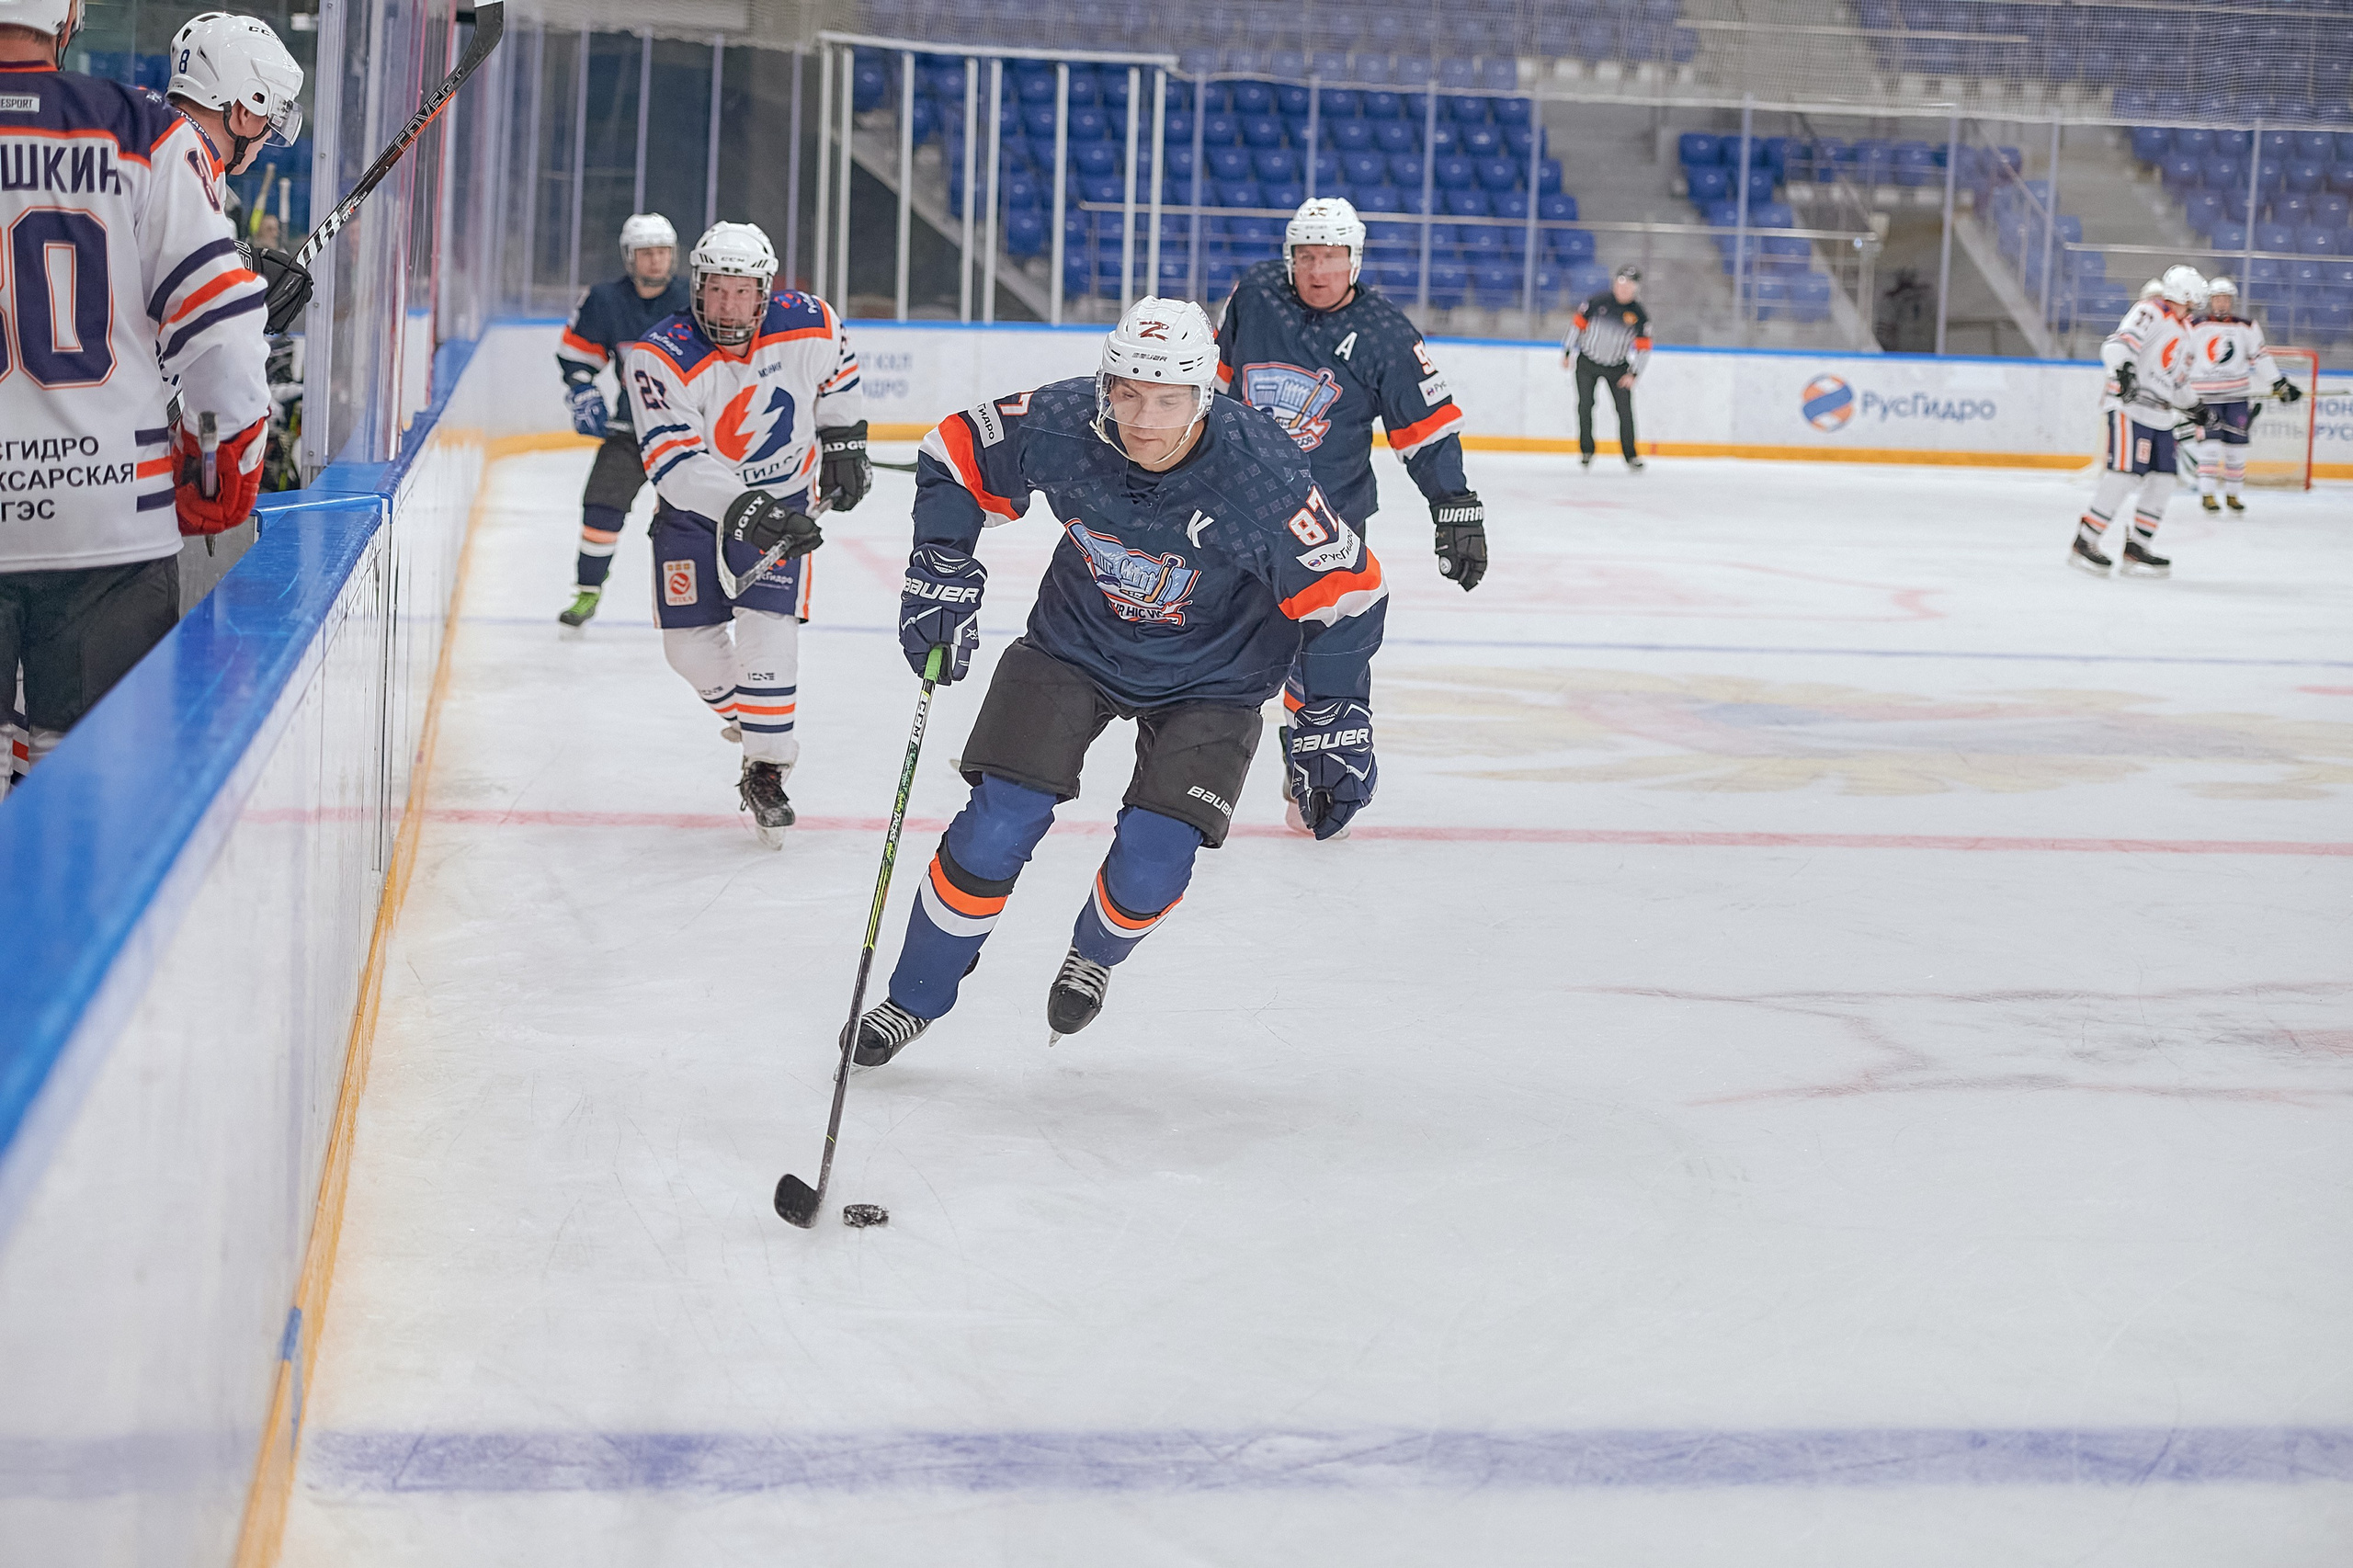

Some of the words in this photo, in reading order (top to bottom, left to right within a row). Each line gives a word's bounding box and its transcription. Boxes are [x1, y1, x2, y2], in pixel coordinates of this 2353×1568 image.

[178, 49, 190, 74] 8
[0, 143, 122, 196] ШКИН
[0, 206, 118, 391] 0
[1862, 390, 1996, 424] РусГидро
[0, 436, 99, 462] ГИДРО
[824, 442, 846, 454] AD
[0, 499, 55, 523] ГЭС
[1288, 485, 1338, 547] 87
[1319, 529, 1354, 562] РусГидро
[1127, 607, 1146, 619] HIC
[913, 699, 927, 738] CCM
[889, 811, 903, 841] TACKS
